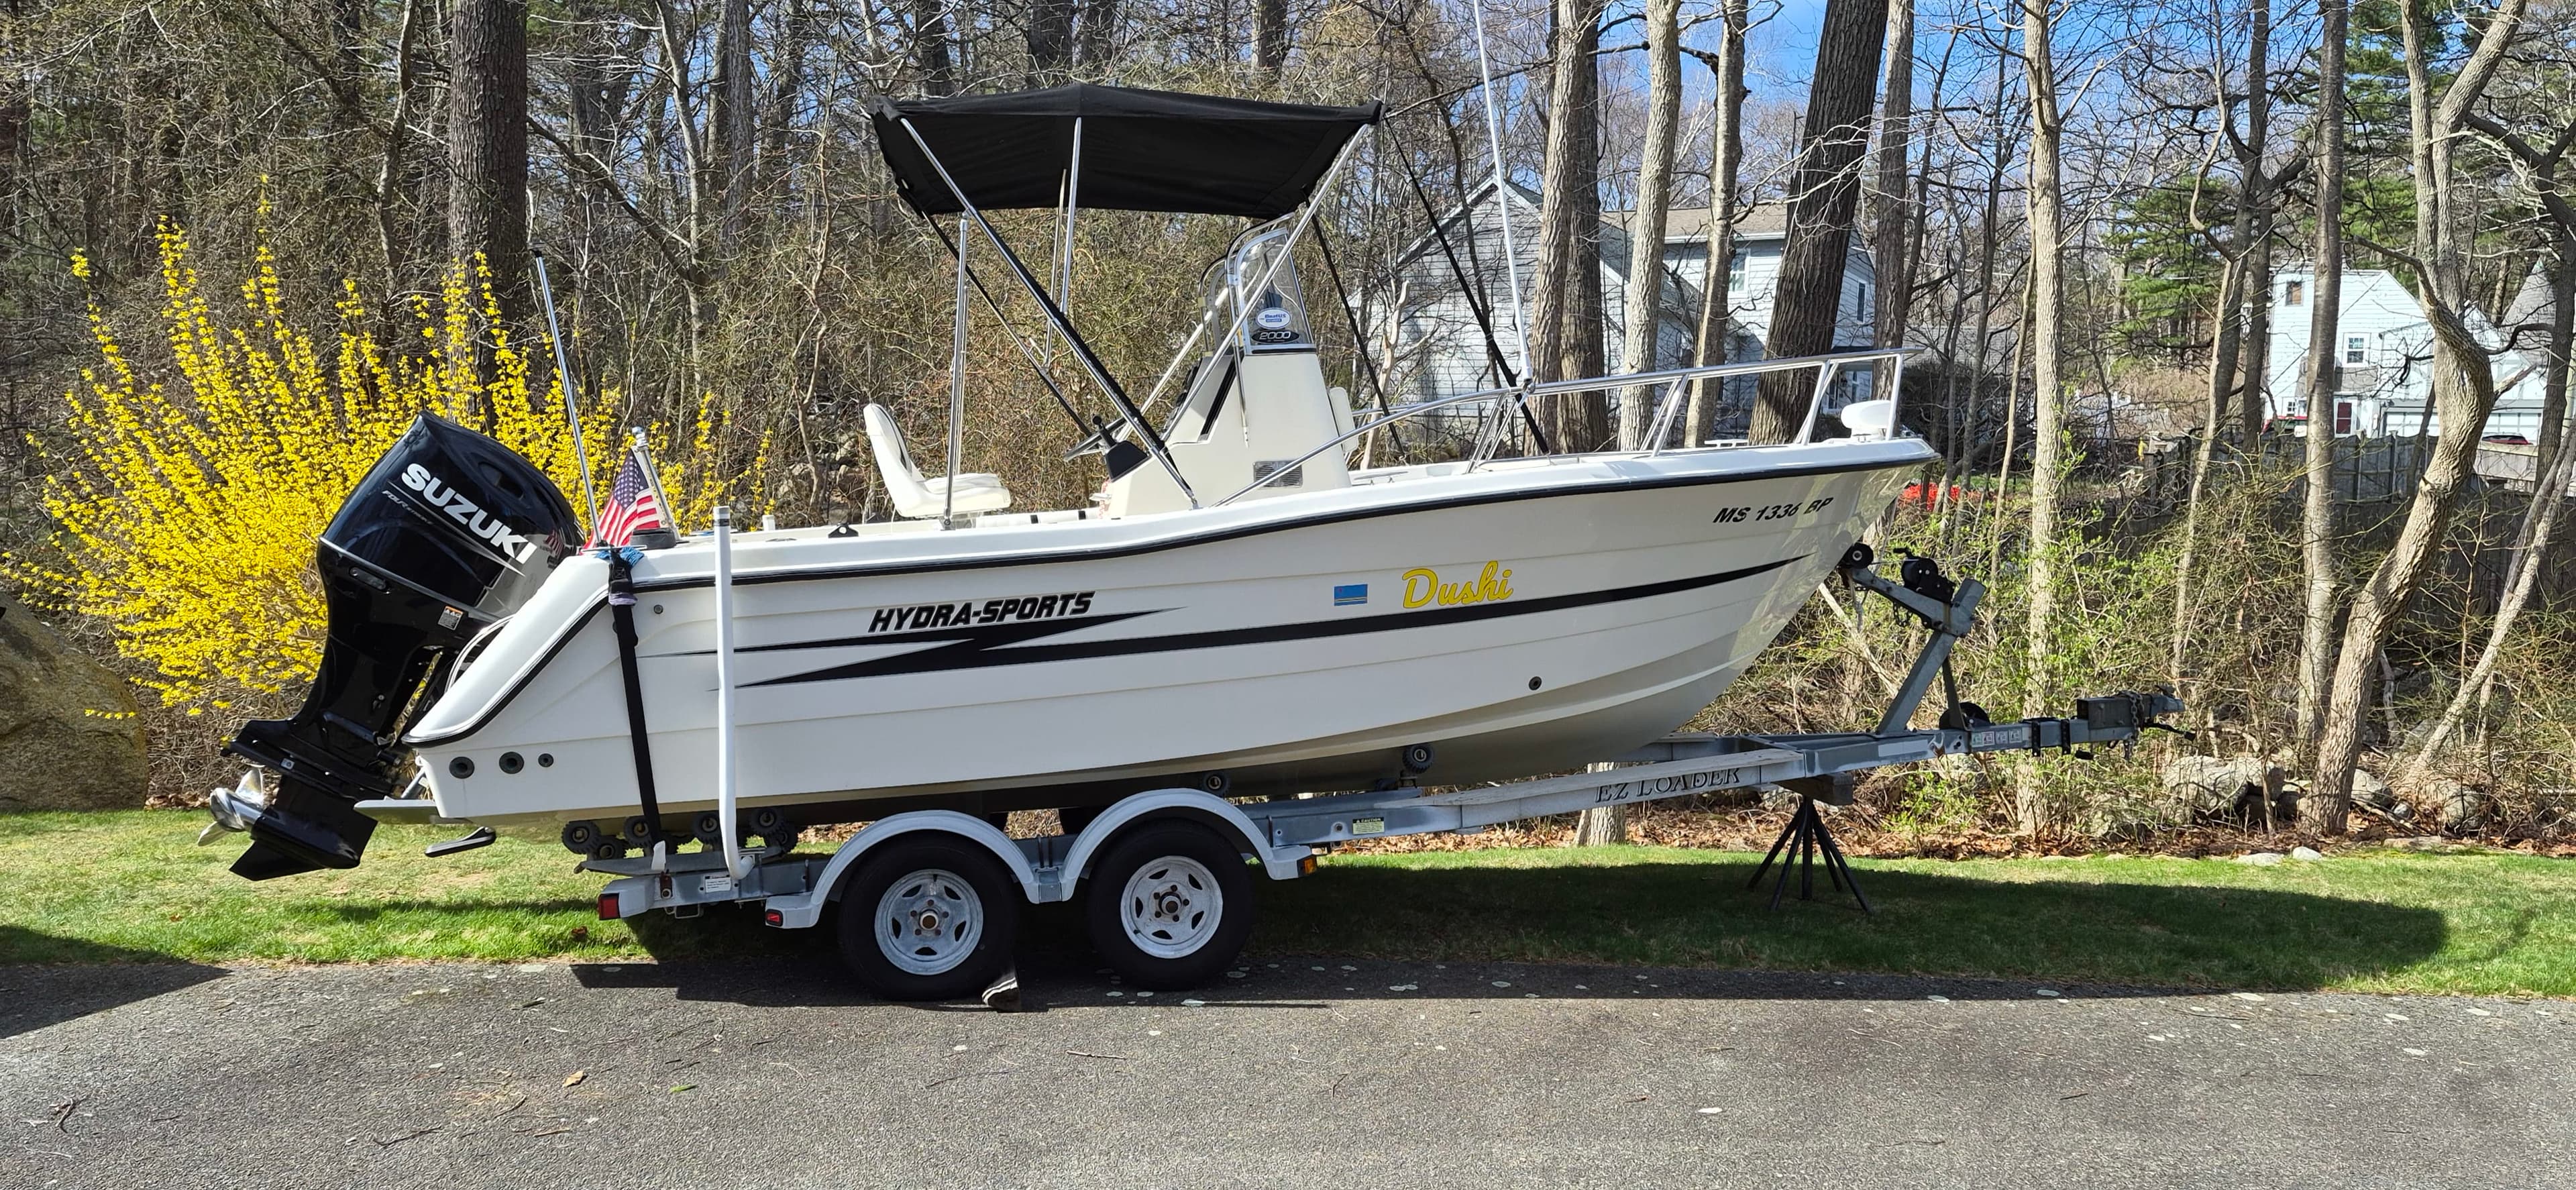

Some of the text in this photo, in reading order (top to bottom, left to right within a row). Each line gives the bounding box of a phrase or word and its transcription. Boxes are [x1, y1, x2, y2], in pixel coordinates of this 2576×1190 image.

[1259, 331, 1291, 340] 2000
[401, 463, 537, 565] SUZUKI
[1713, 497, 1834, 523] MS 1336 BP
[1402, 560, 1513, 608] Dushi
[868, 591, 1095, 633] HYDRA-SPORTS
[1595, 768, 1740, 803] EZ LOADER
